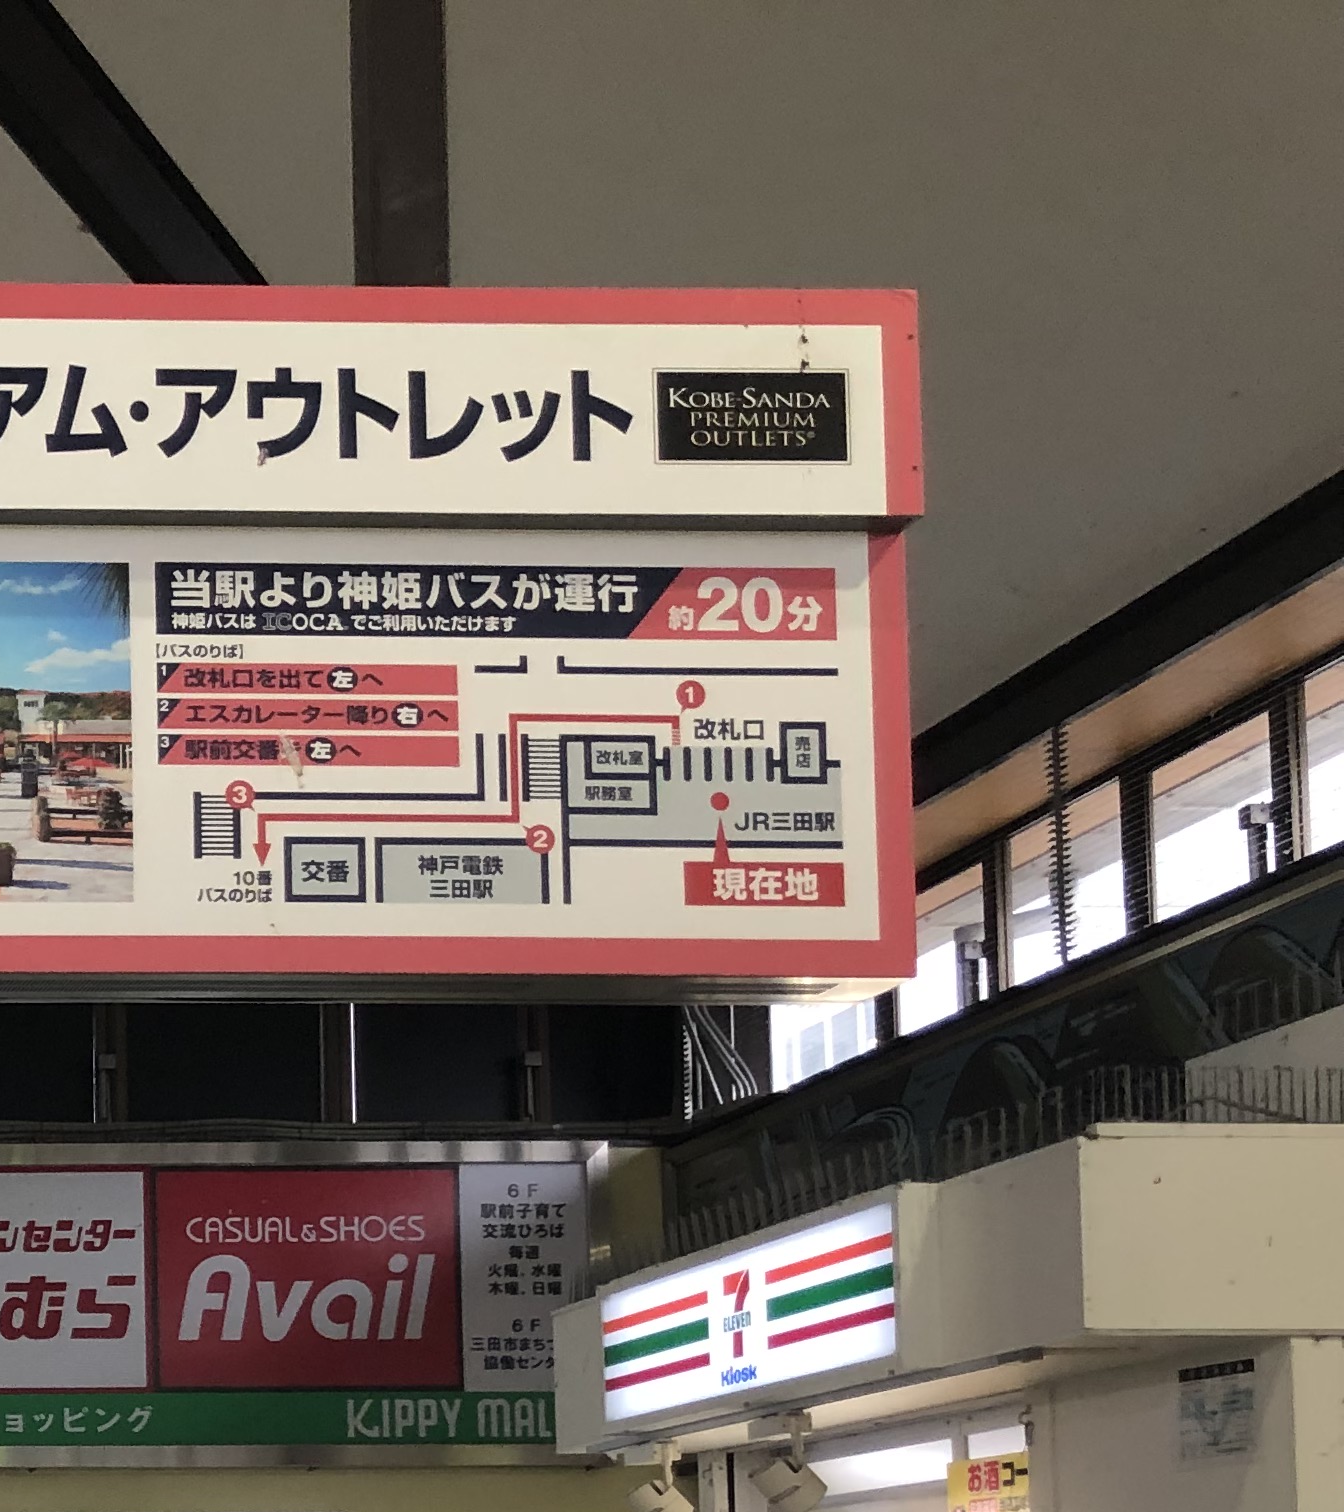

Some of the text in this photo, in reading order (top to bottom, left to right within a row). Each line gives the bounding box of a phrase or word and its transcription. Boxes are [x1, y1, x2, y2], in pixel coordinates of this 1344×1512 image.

[690, 411, 816, 428] PREMIUM
[170, 568, 639, 614] 当駅より神姫バスが運行
[668, 576, 824, 633] 約20分
[183, 666, 384, 693] 改札口を出て左へ
[684, 686, 695, 704] 1
[694, 718, 765, 741] 改札口
[232, 785, 248, 804] 3
[734, 811, 836, 832] JR三田駅
[532, 829, 549, 848] 2
[302, 859, 350, 883] 交番
[418, 855, 504, 876] 神戸電鉄
[197, 888, 272, 903] バスのりば
[429, 879, 494, 899] 三田駅
[713, 867, 819, 901] 現在地
[185, 1214, 427, 1245] CASUAL&SHOES
[178, 1253, 437, 1342] Avail
[347, 1398, 554, 1438] KIPPY MAL
